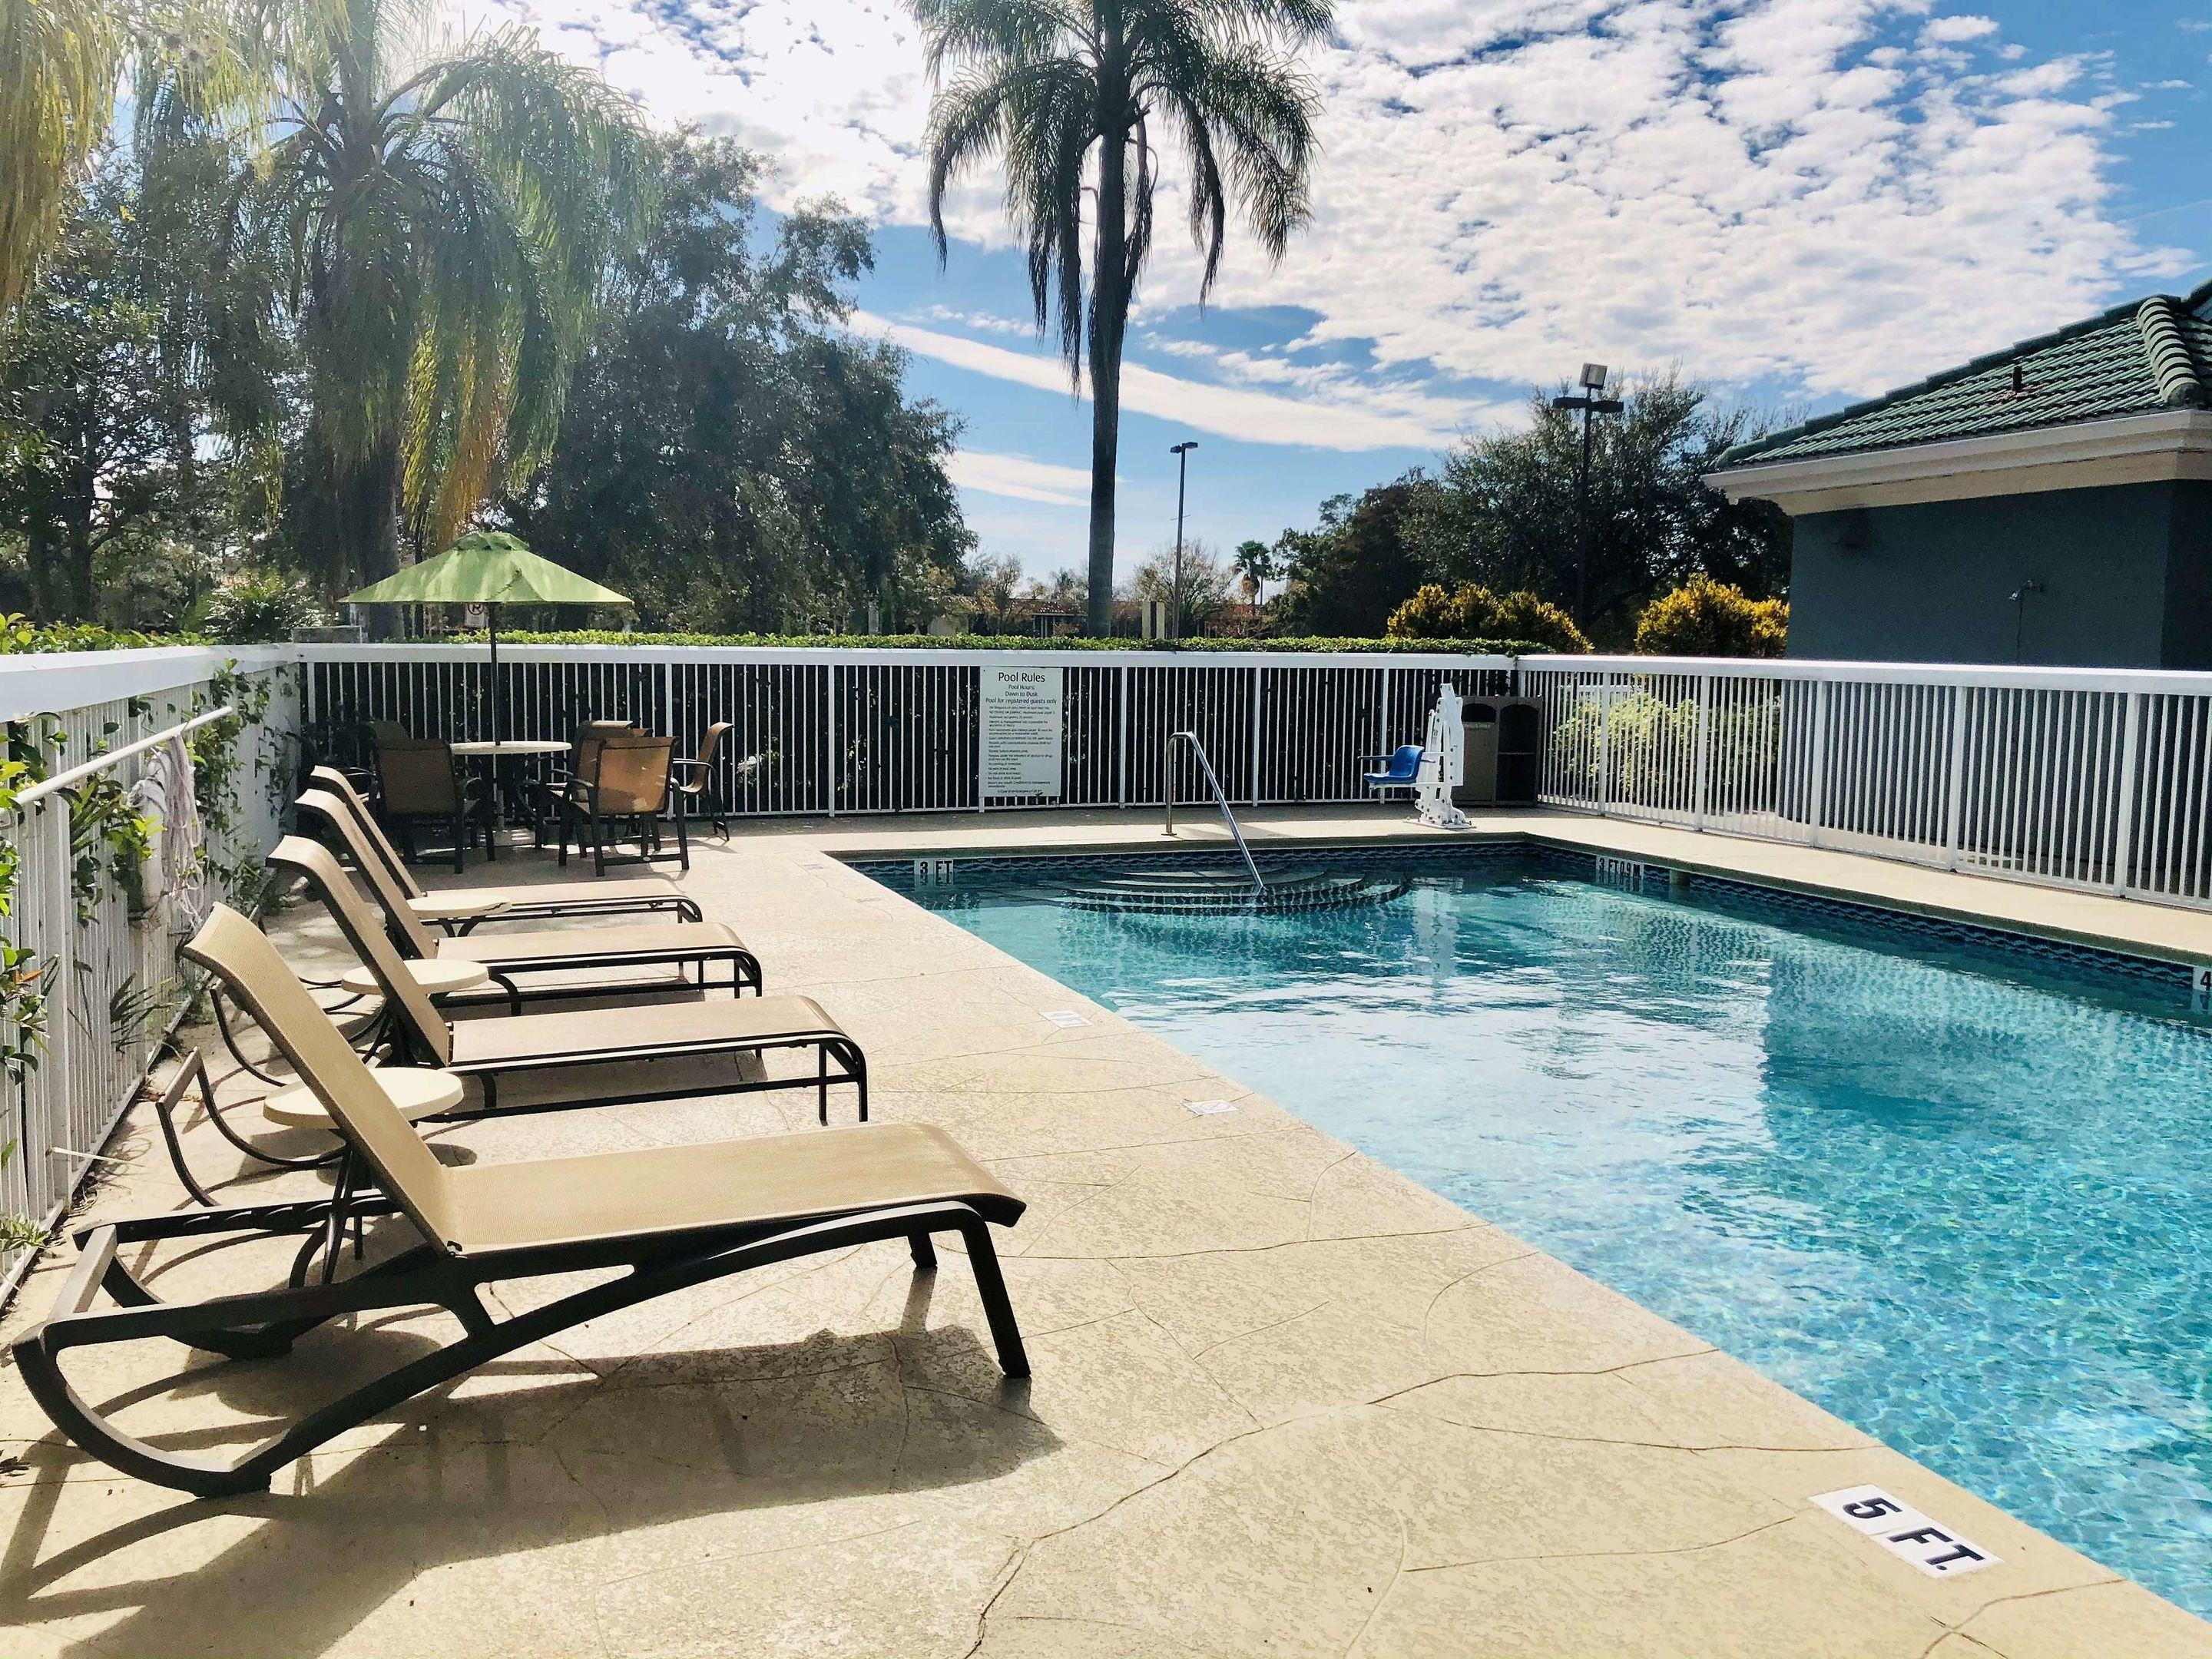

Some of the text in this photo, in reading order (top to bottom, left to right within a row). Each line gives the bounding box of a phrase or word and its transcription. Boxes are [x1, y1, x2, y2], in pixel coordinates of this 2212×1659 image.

[998, 672, 1045, 683] Pool Rules
[920, 861, 929, 875] 3
[1599, 857, 1604, 870] 3
[2200, 970, 2212, 991] 4
[1843, 1497, 1985, 1571] 5 FT.
